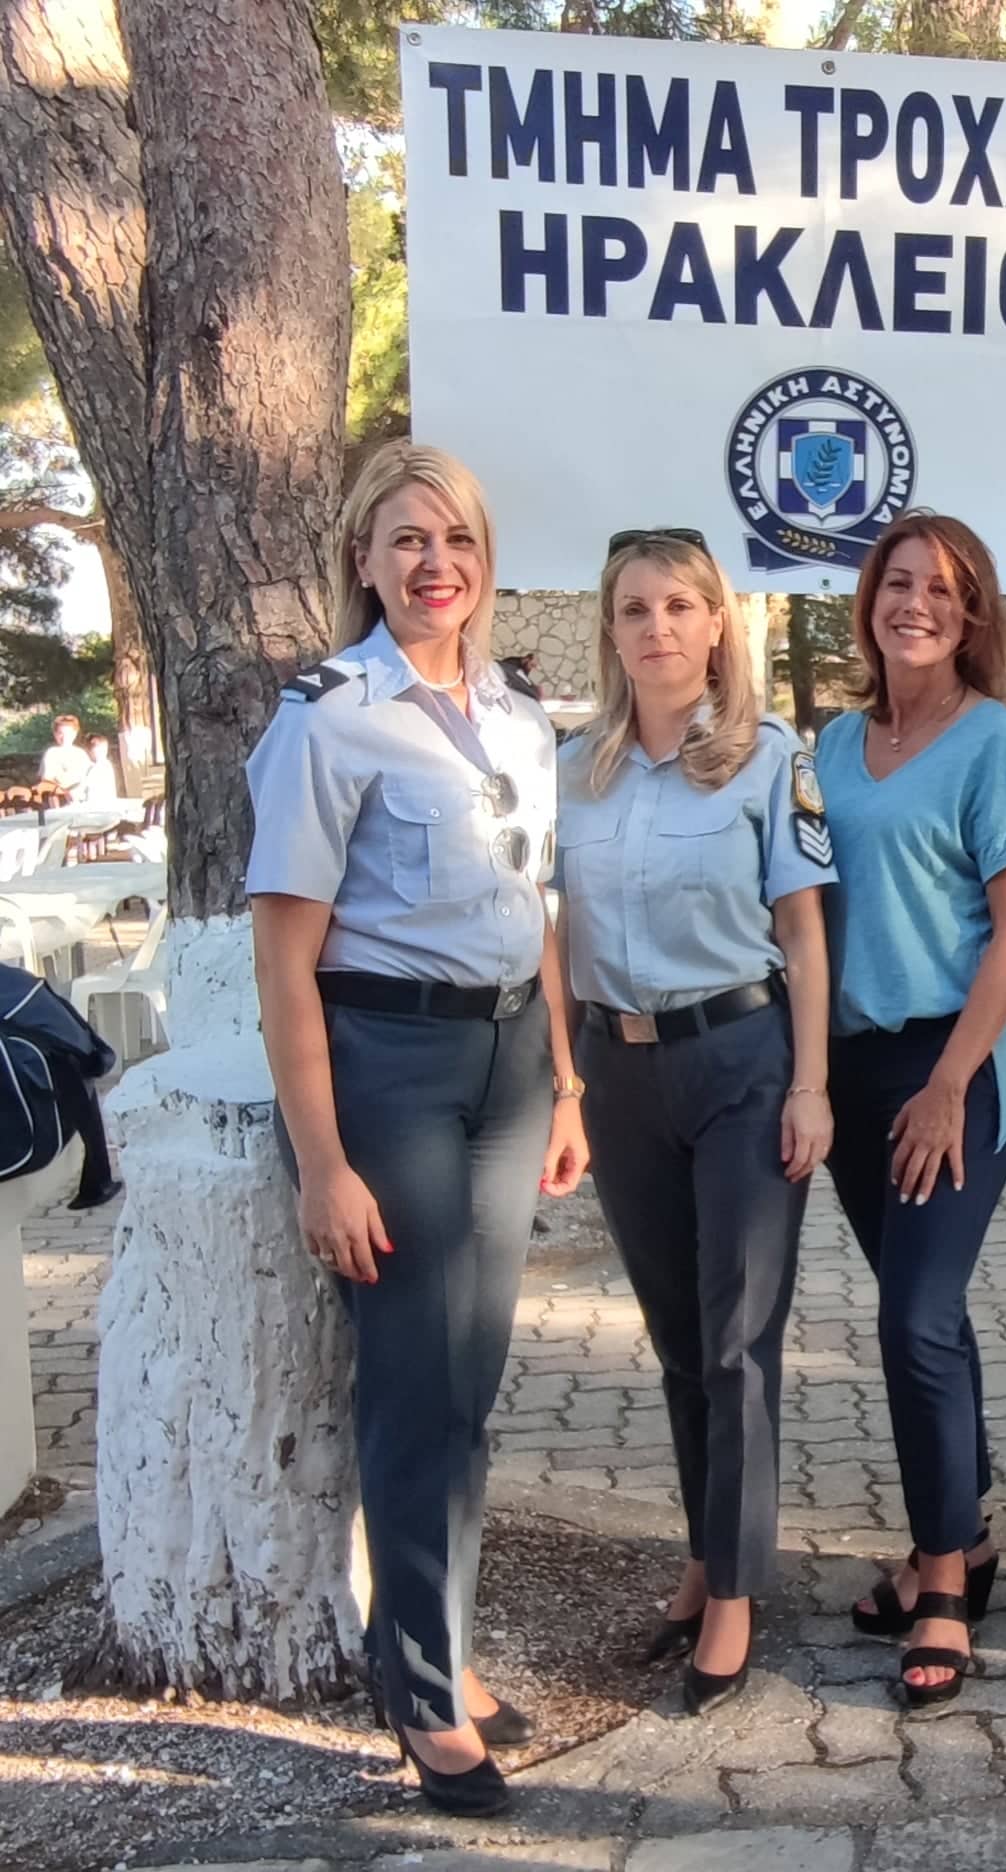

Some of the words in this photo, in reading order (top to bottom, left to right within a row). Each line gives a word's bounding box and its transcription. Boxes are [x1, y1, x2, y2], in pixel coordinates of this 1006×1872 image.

[428, 61, 756, 195] ΤΜΗΜΑ
[735, 376, 810, 521] ΕΛΛΗΝΙΚΗ
[820, 375, 910, 525] ΑΣΤΥΝΟΜΙΑ
